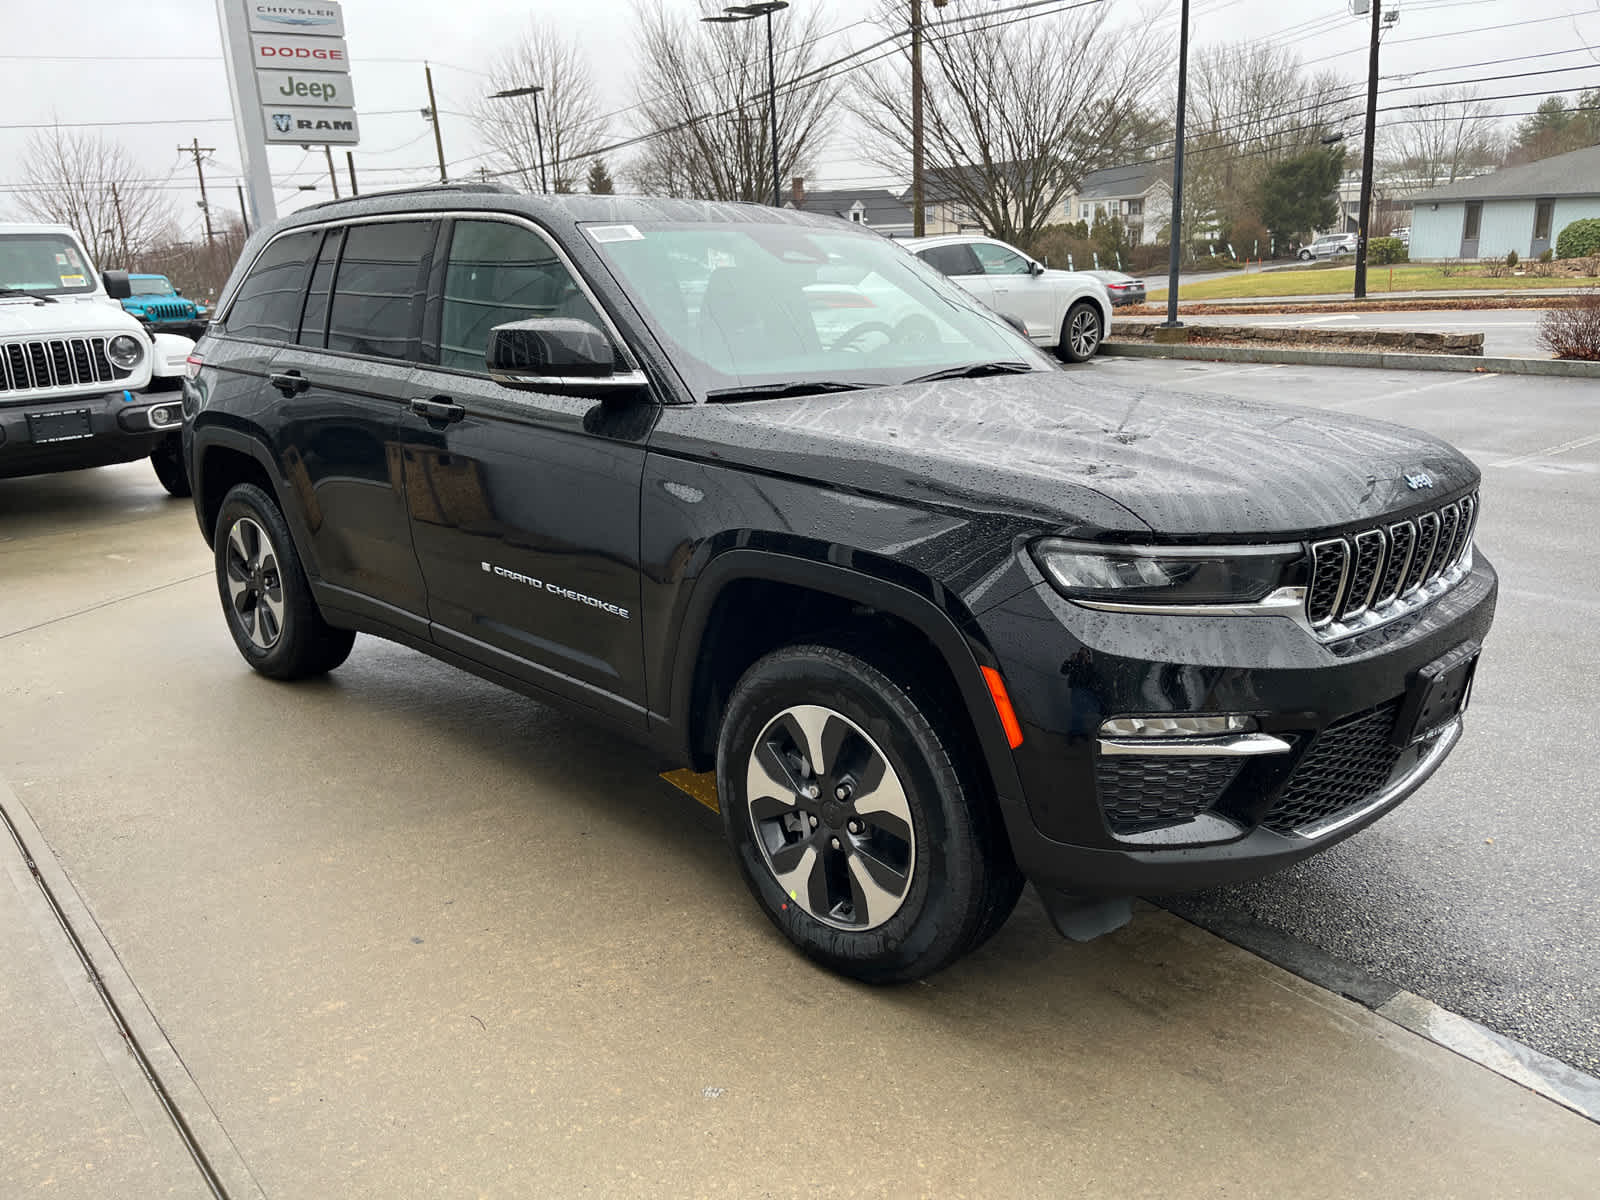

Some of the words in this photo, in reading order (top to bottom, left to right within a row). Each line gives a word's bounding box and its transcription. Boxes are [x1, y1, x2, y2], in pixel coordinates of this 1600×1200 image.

[256, 6, 334, 17] CHRYSLER
[260, 46, 344, 60] DODGE
[280, 76, 336, 101] Jeep
[297, 119, 353, 131] RAM
[494, 566, 542, 589] GRAND
[546, 583, 630, 619] CHEROKEE
